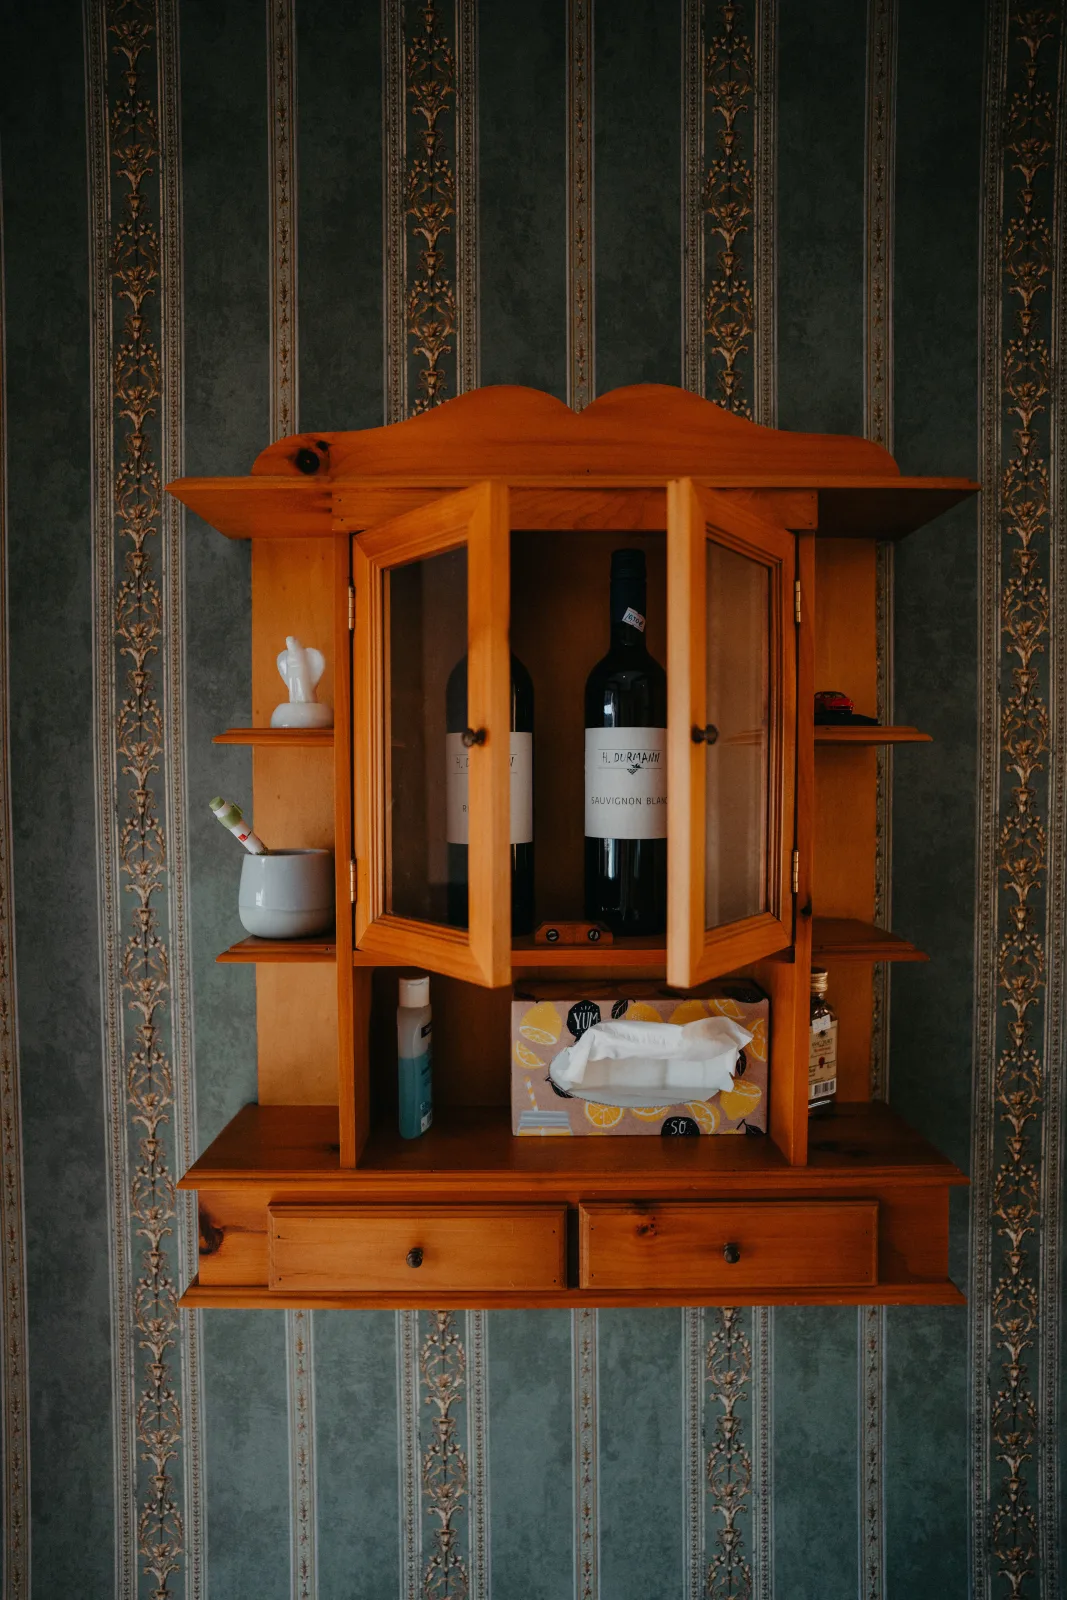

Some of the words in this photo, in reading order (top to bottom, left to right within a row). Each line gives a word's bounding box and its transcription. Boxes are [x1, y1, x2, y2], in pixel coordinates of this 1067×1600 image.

[602, 752, 611, 763] H.
[614, 751, 660, 764] DURMANN
[591, 796, 642, 805] SAUVIGNON
[573, 1012, 599, 1030] YUM
[671, 1120, 687, 1135] SO
